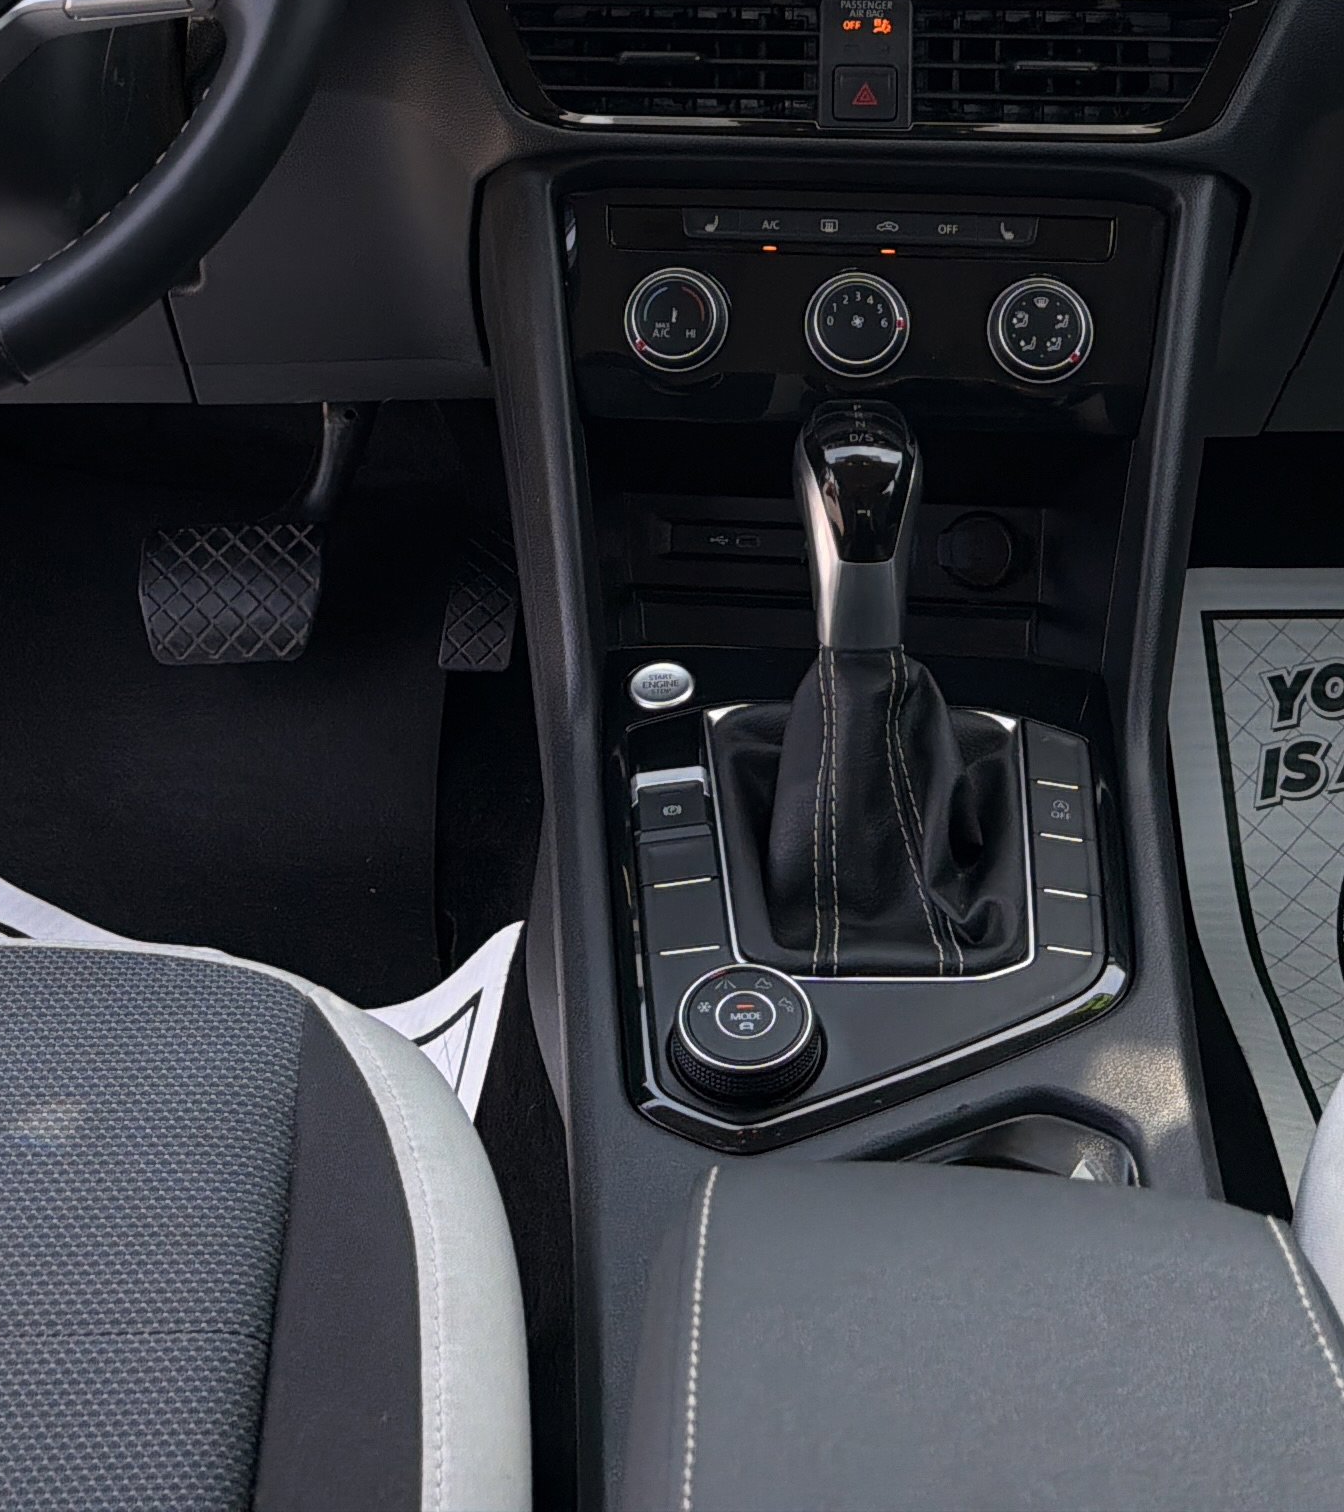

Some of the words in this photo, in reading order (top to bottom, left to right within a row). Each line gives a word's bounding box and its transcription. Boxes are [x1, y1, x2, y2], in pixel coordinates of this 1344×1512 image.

[840, 0, 893, 9] PASSENGER
[842, 19, 862, 31] OFF
[761, 219, 780, 231] A/C
[937, 223, 959, 235] OFF
[842, 294, 849, 305] 2
[855, 291, 862, 302] 3
[866, 295, 874, 305] 4
[832, 302, 838, 313] 1
[876, 303, 883, 314] 5
[826, 316, 835, 327] 0
[880, 317, 889, 328] 6
[652, 329, 671, 339] A/C
[685, 329, 697, 339] HI
[855, 420, 866, 428] N
[849, 433, 875, 443] D/S
[642, 679, 680, 689] ENGINE
[1257, 736, 1327, 804] IS
[730, 1012, 762, 1021] MODE
